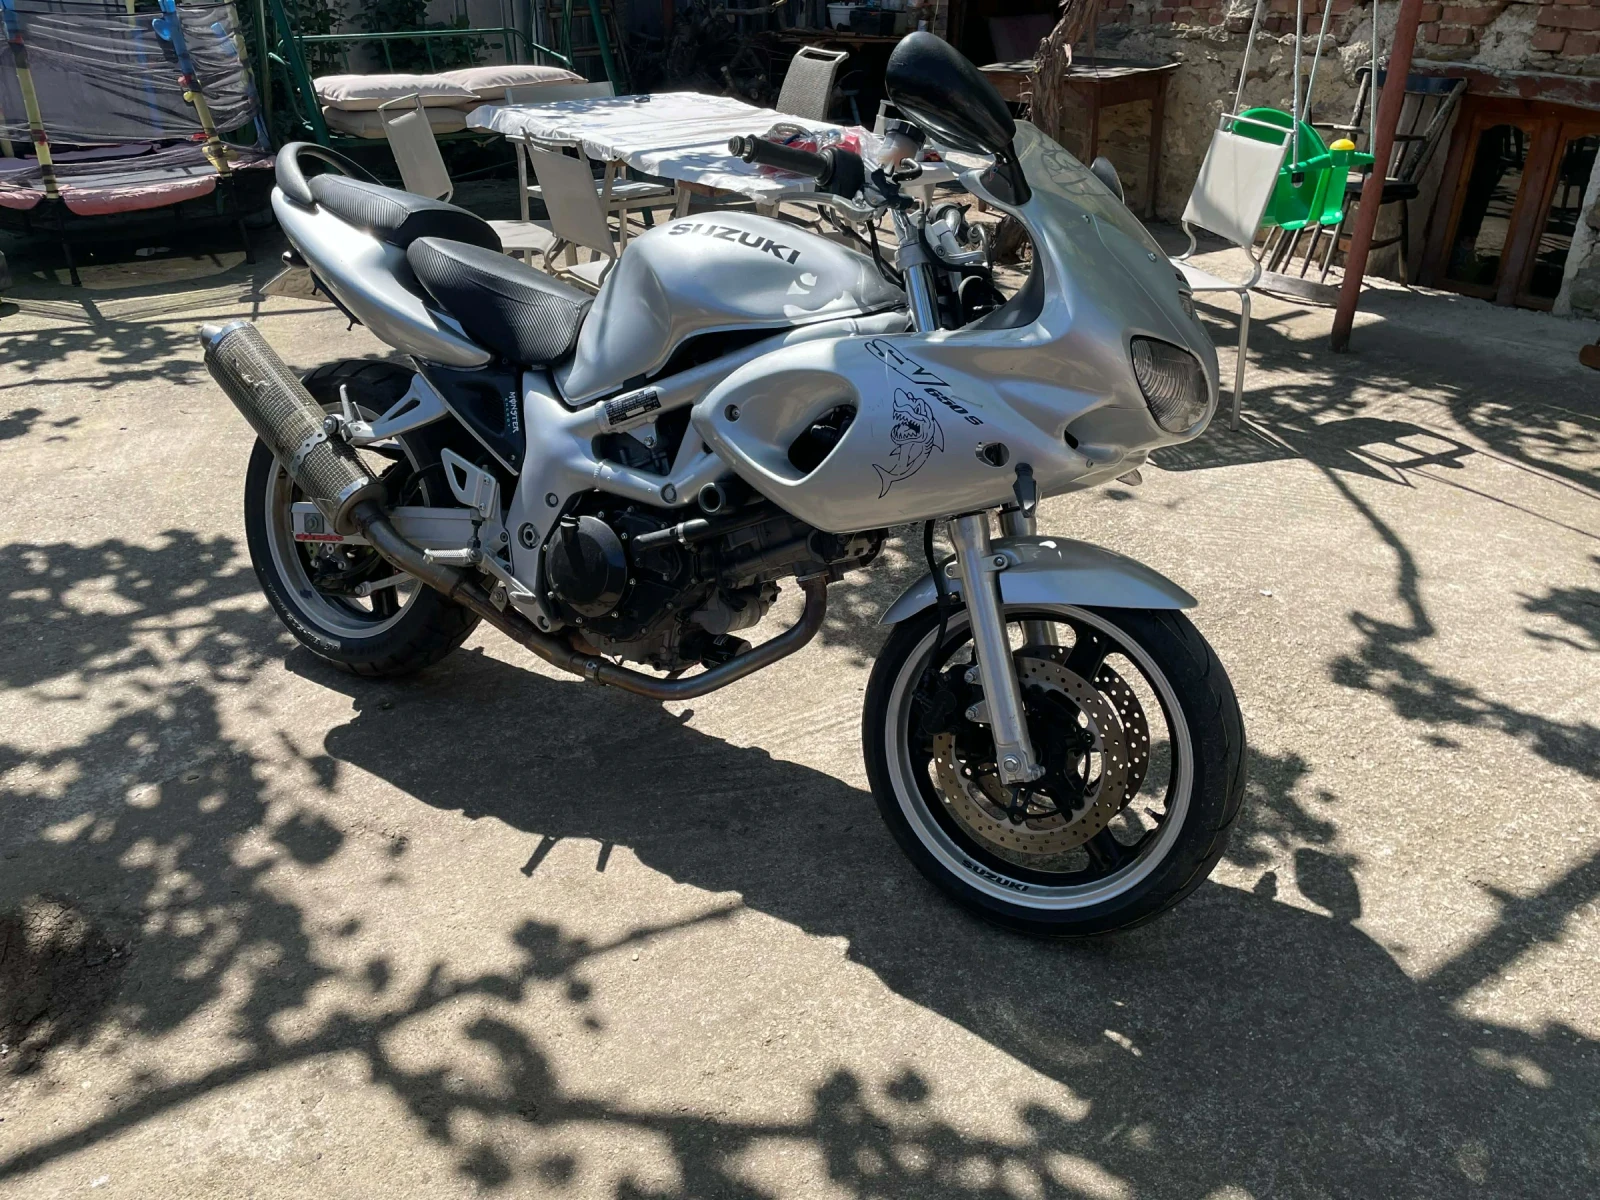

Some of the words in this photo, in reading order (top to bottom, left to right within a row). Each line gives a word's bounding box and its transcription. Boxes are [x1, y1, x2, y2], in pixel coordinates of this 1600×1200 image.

[668, 223, 801, 265] SUZUKI
[509, 391, 519, 433] MONSTER
[962, 860, 1029, 891] SUZUKI
